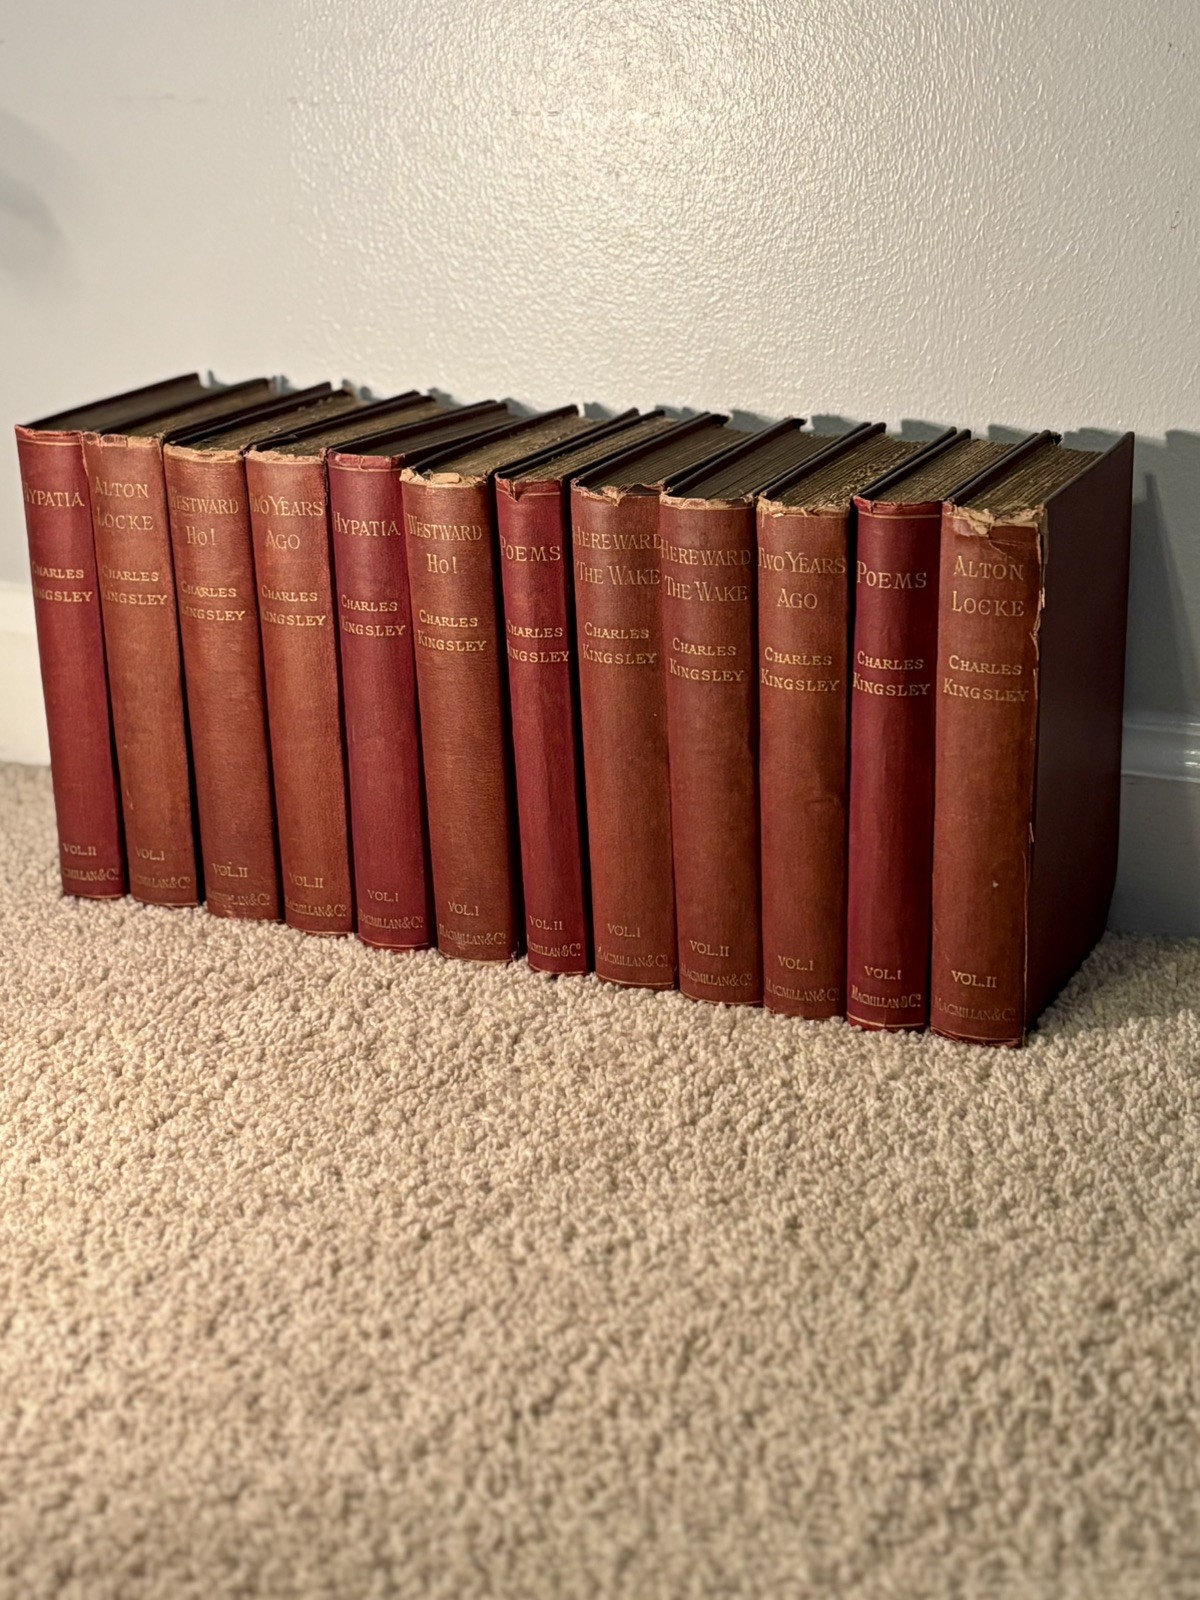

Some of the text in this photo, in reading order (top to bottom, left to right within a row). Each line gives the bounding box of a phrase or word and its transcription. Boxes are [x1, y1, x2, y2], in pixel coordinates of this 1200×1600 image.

[95, 476, 149, 499] ALTON
[250, 495, 324, 516] WO YEARS
[97, 507, 154, 530] LOCKE
[333, 512, 402, 537] HYPATIA
[407, 513, 483, 542] WESTWARD
[265, 529, 301, 550] AGO
[500, 535, 561, 562] POEMS
[575, 526, 663, 550] HEREWARD
[661, 538, 751, 566] HEREWARD
[758, 546, 846, 574] TWO YEARS
[102, 565, 159, 581] CHARLES
[576, 561, 661, 586] THE WAKE
[856, 560, 927, 589] POEMS
[953, 555, 1024, 581] ALTON
[36, 586, 93, 602] NGSLEY
[105, 590, 168, 605] INGSLEY
[180, 580, 237, 598] CHARLES
[261, 584, 318, 602] CHARLES
[664, 575, 748, 602] THE WAKE
[776, 588, 818, 610] AGO
[182, 606, 246, 621] INGSLEY
[341, 594, 398, 612] CHARLES
[952, 590, 1024, 617] LOCKE
[262, 610, 326, 626] INGSLEY
[418, 609, 479, 628] CHARLES
[507, 619, 564, 639] CHARLES
[417, 630, 487, 652] KINGSLEY
[584, 622, 650, 640] CHARLES
[582, 643, 657, 665] KINGSLEY
[672, 637, 737, 656] CHARLES
[764, 646, 833, 666] CHARLES
[669, 657, 745, 683] KINGSLEY
[857, 651, 924, 670] CHARLES
[949, 655, 1022, 675] CHARLES
[761, 667, 840, 692] KINGSLEY
[852, 672, 931, 697] KINGSLEY
[943, 677, 1029, 702] KINGSLEY
